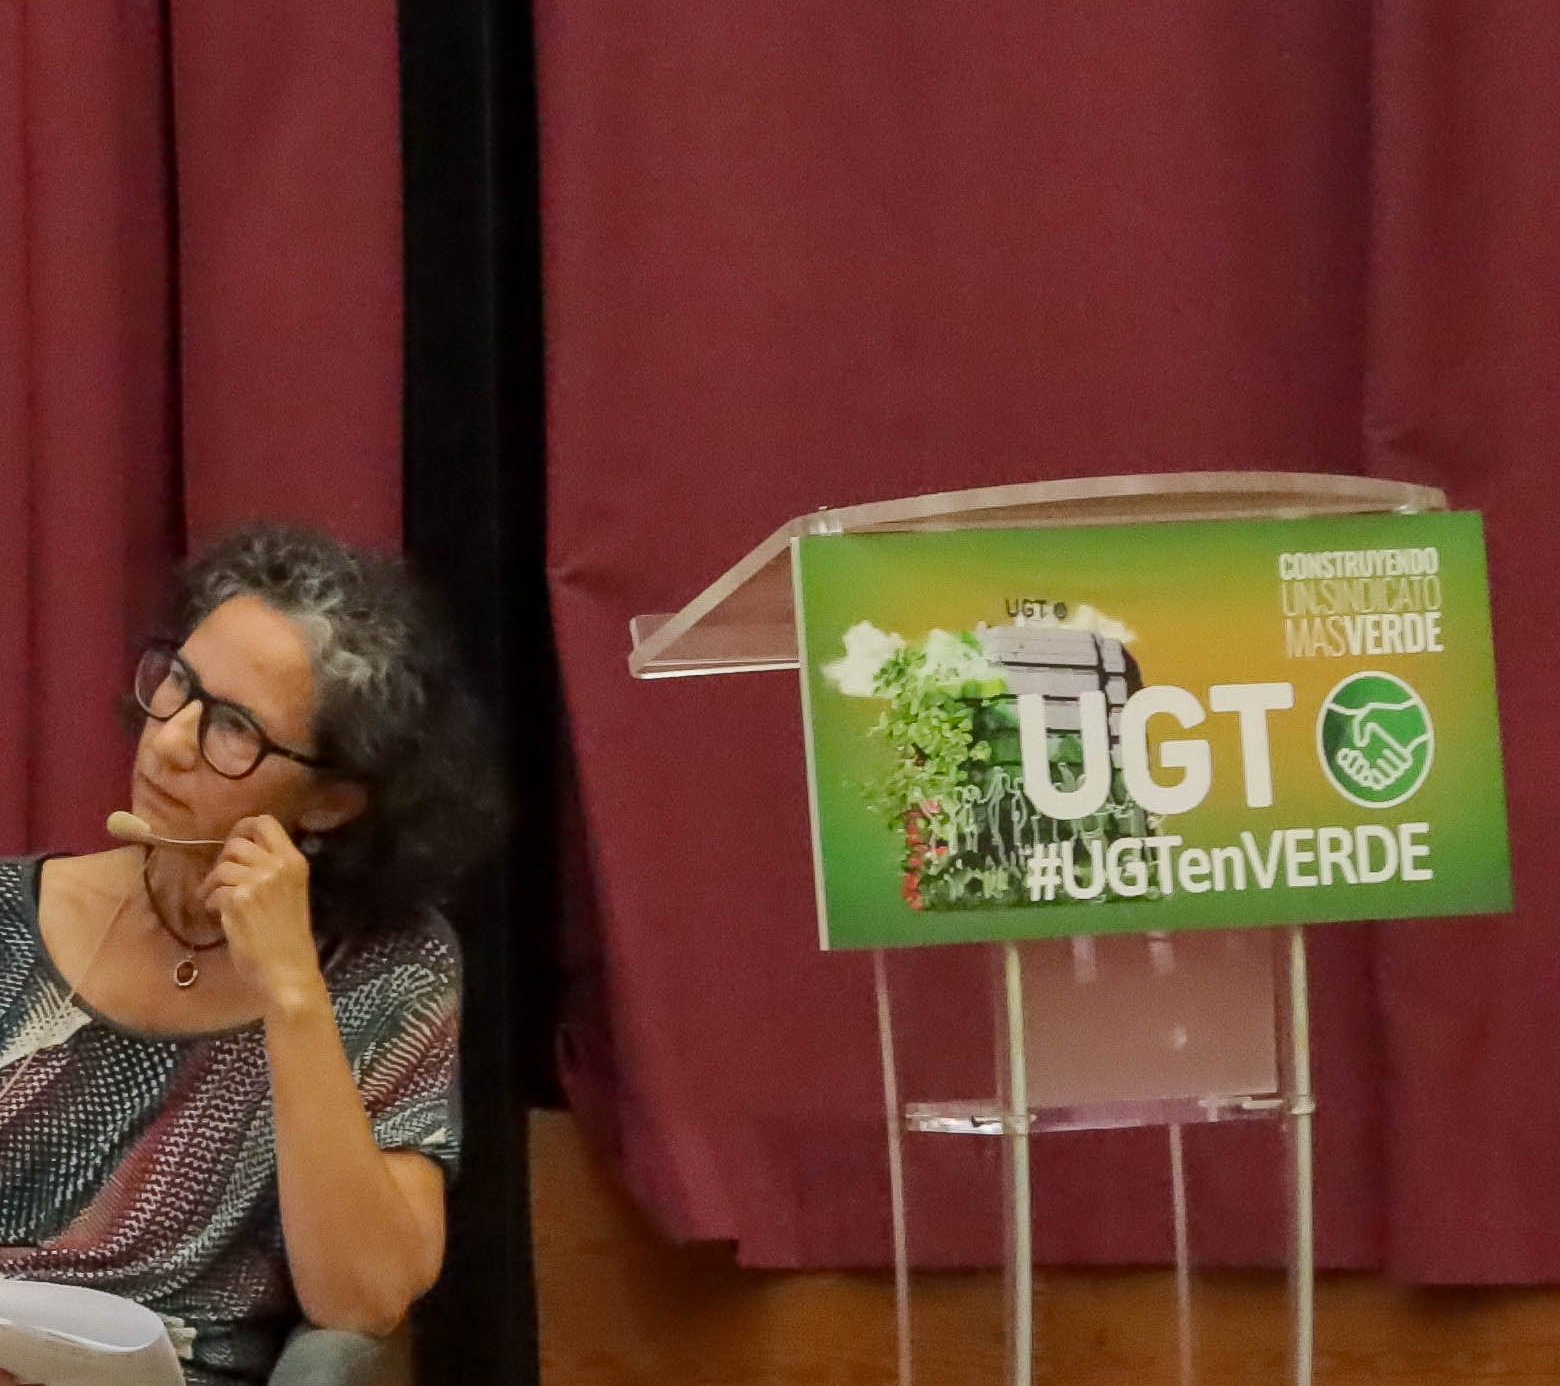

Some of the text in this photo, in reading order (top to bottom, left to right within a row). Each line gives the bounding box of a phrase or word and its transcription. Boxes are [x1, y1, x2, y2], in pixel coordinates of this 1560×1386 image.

[1278, 547, 1439, 581] CONSTRUYENDO
[1005, 597, 1047, 620] UGT
[1017, 681, 1296, 821] UGT
[1026, 821, 1434, 903] #UGTenVERDE
